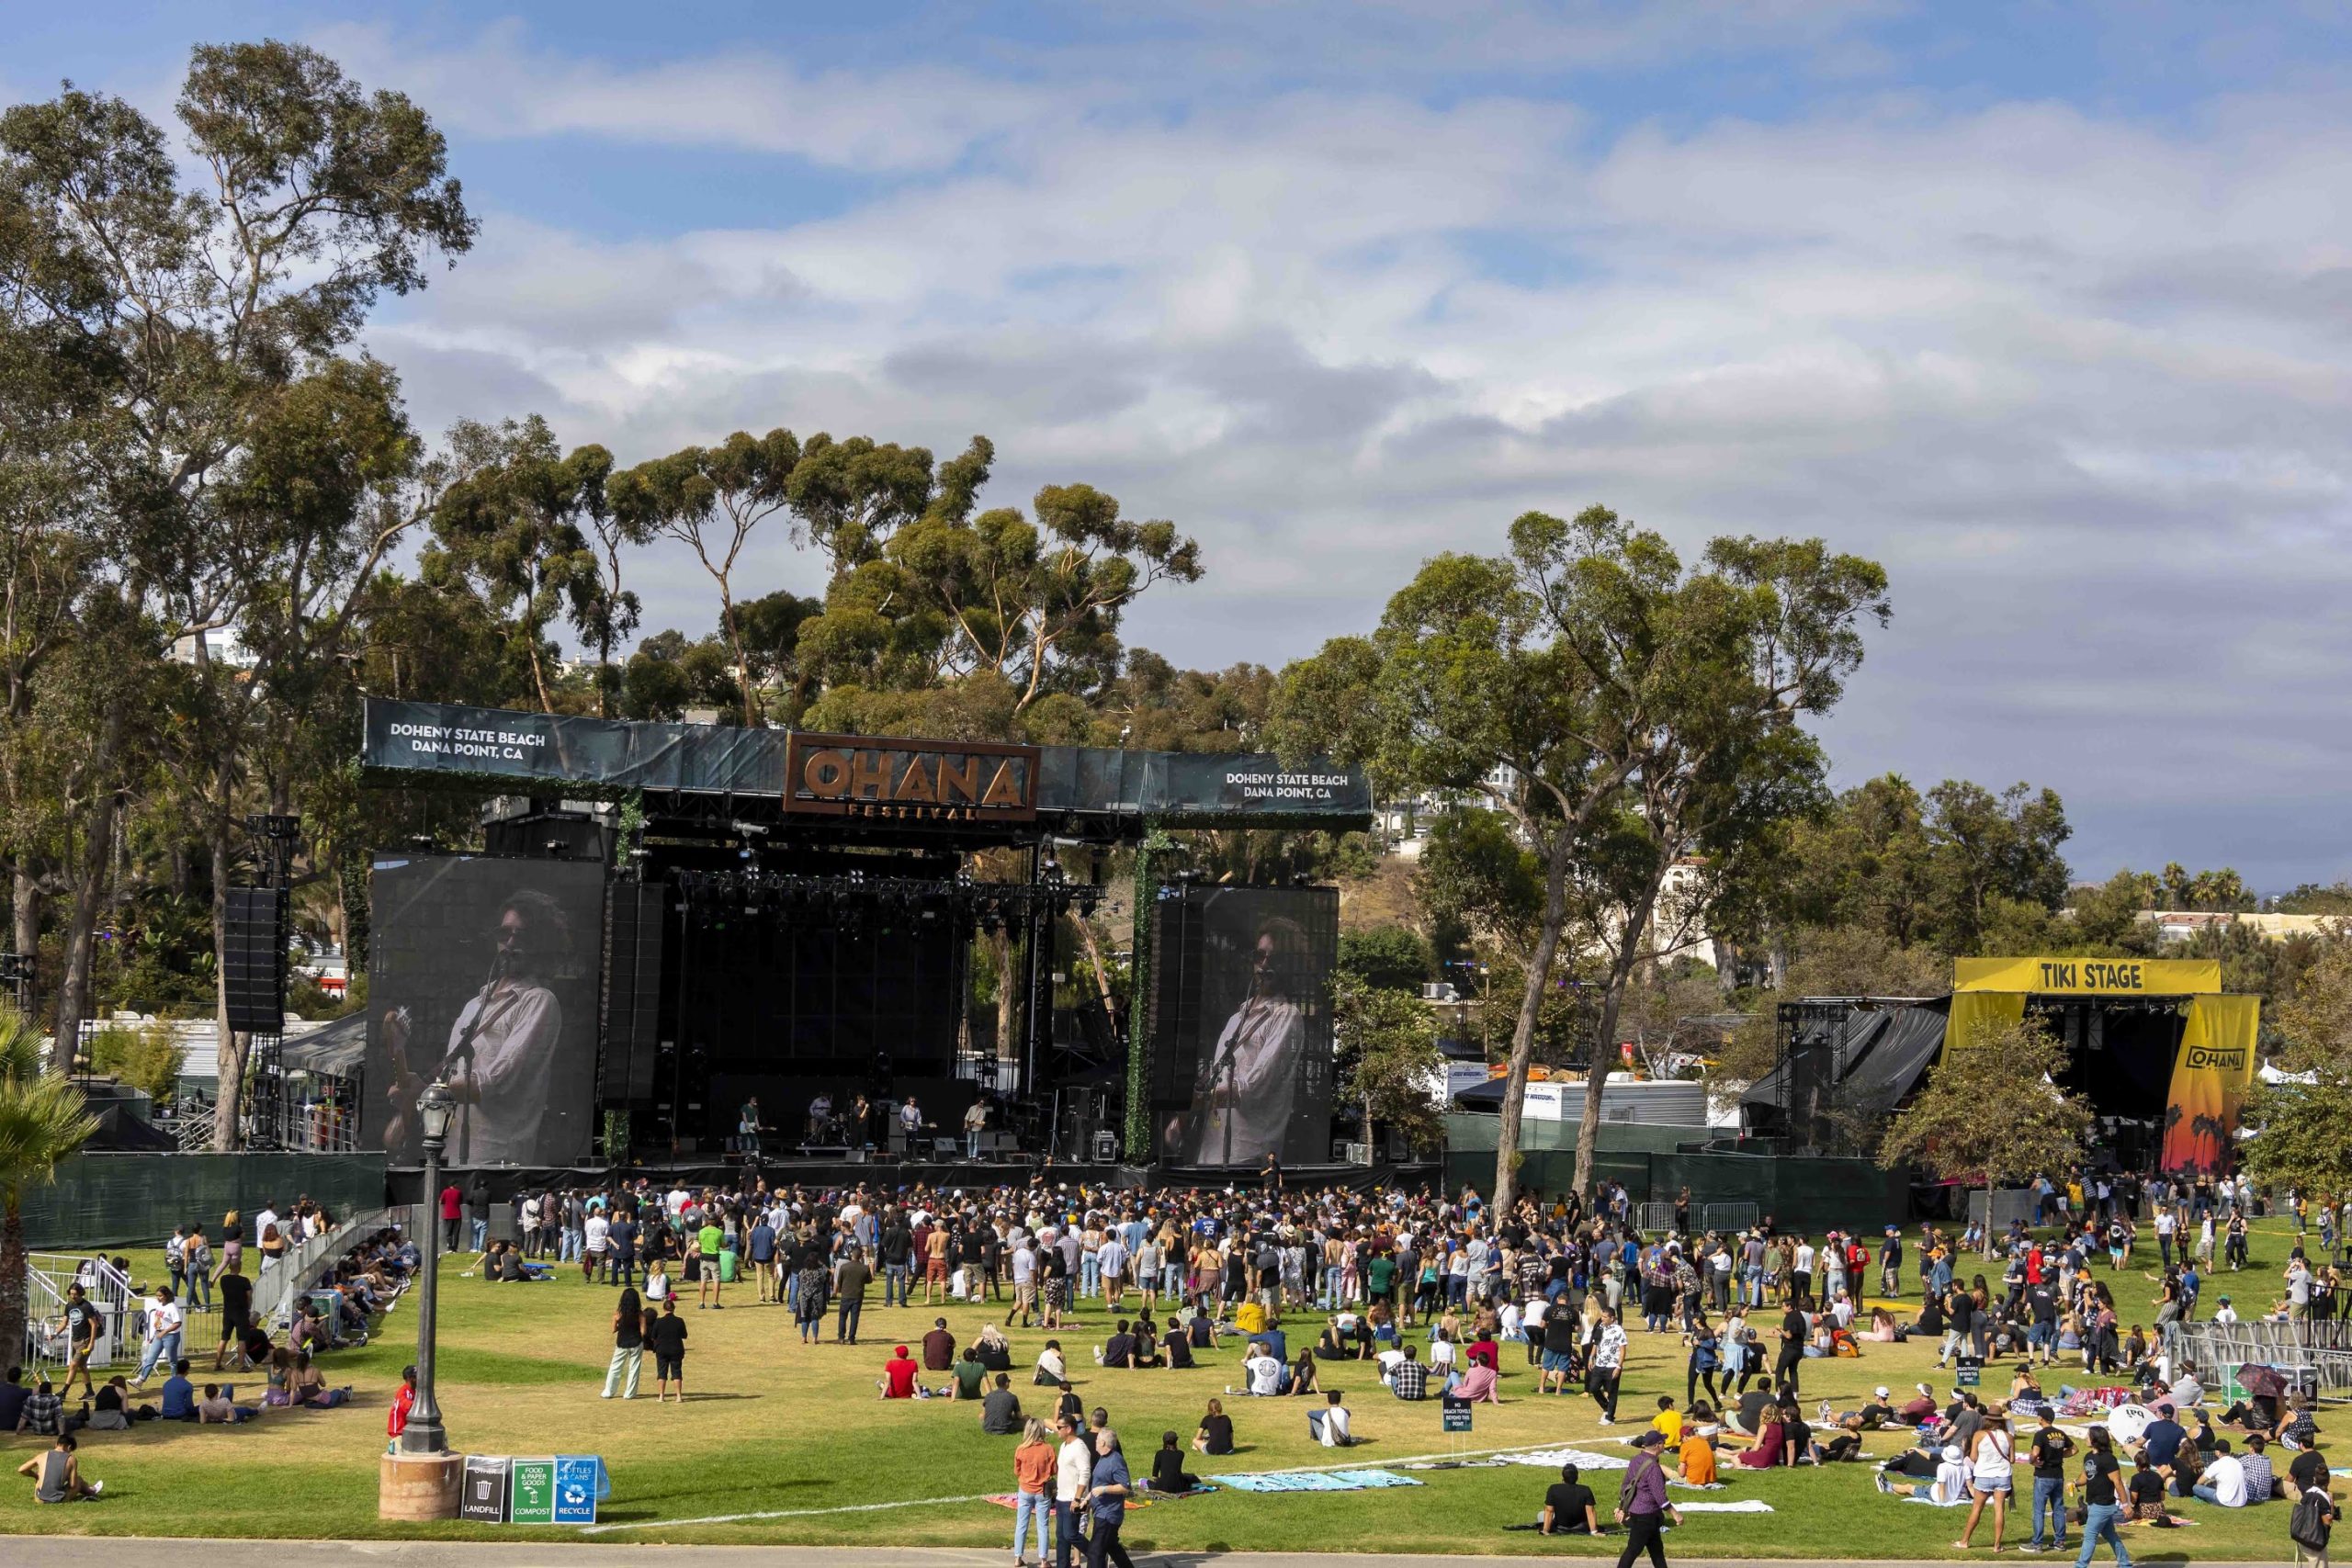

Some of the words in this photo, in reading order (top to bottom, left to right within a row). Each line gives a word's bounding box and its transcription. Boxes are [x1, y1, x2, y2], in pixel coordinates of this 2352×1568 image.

[390, 723, 453, 739] DOHENY
[455, 728, 495, 743] STATE
[498, 732, 546, 747] BEACH
[412, 739, 451, 754] DANA
[454, 742, 500, 760] POINT,
[503, 748, 524, 761] CA
[804, 750, 1022, 806] OHANA
[1227, 773, 1274, 784] DOHENY
[1277, 773, 1309, 785] STATE
[1312, 774, 1348, 786] BEACH
[1244, 786, 1274, 798] DANA
[1276, 787, 1314, 800] POINT,
[1316, 788, 1332, 799] CA
[848, 803, 976, 821] FESTIVAL
[2041, 963, 2076, 988] TIKI
[2084, 964, 2143, 989] STAGE
[2192, 1050, 2240, 1067] OHANA
[1204, 1225, 1215, 1235] 35
[464, 1505, 500, 1515] LANDFILL
[514, 1507, 551, 1516] COMPOST
